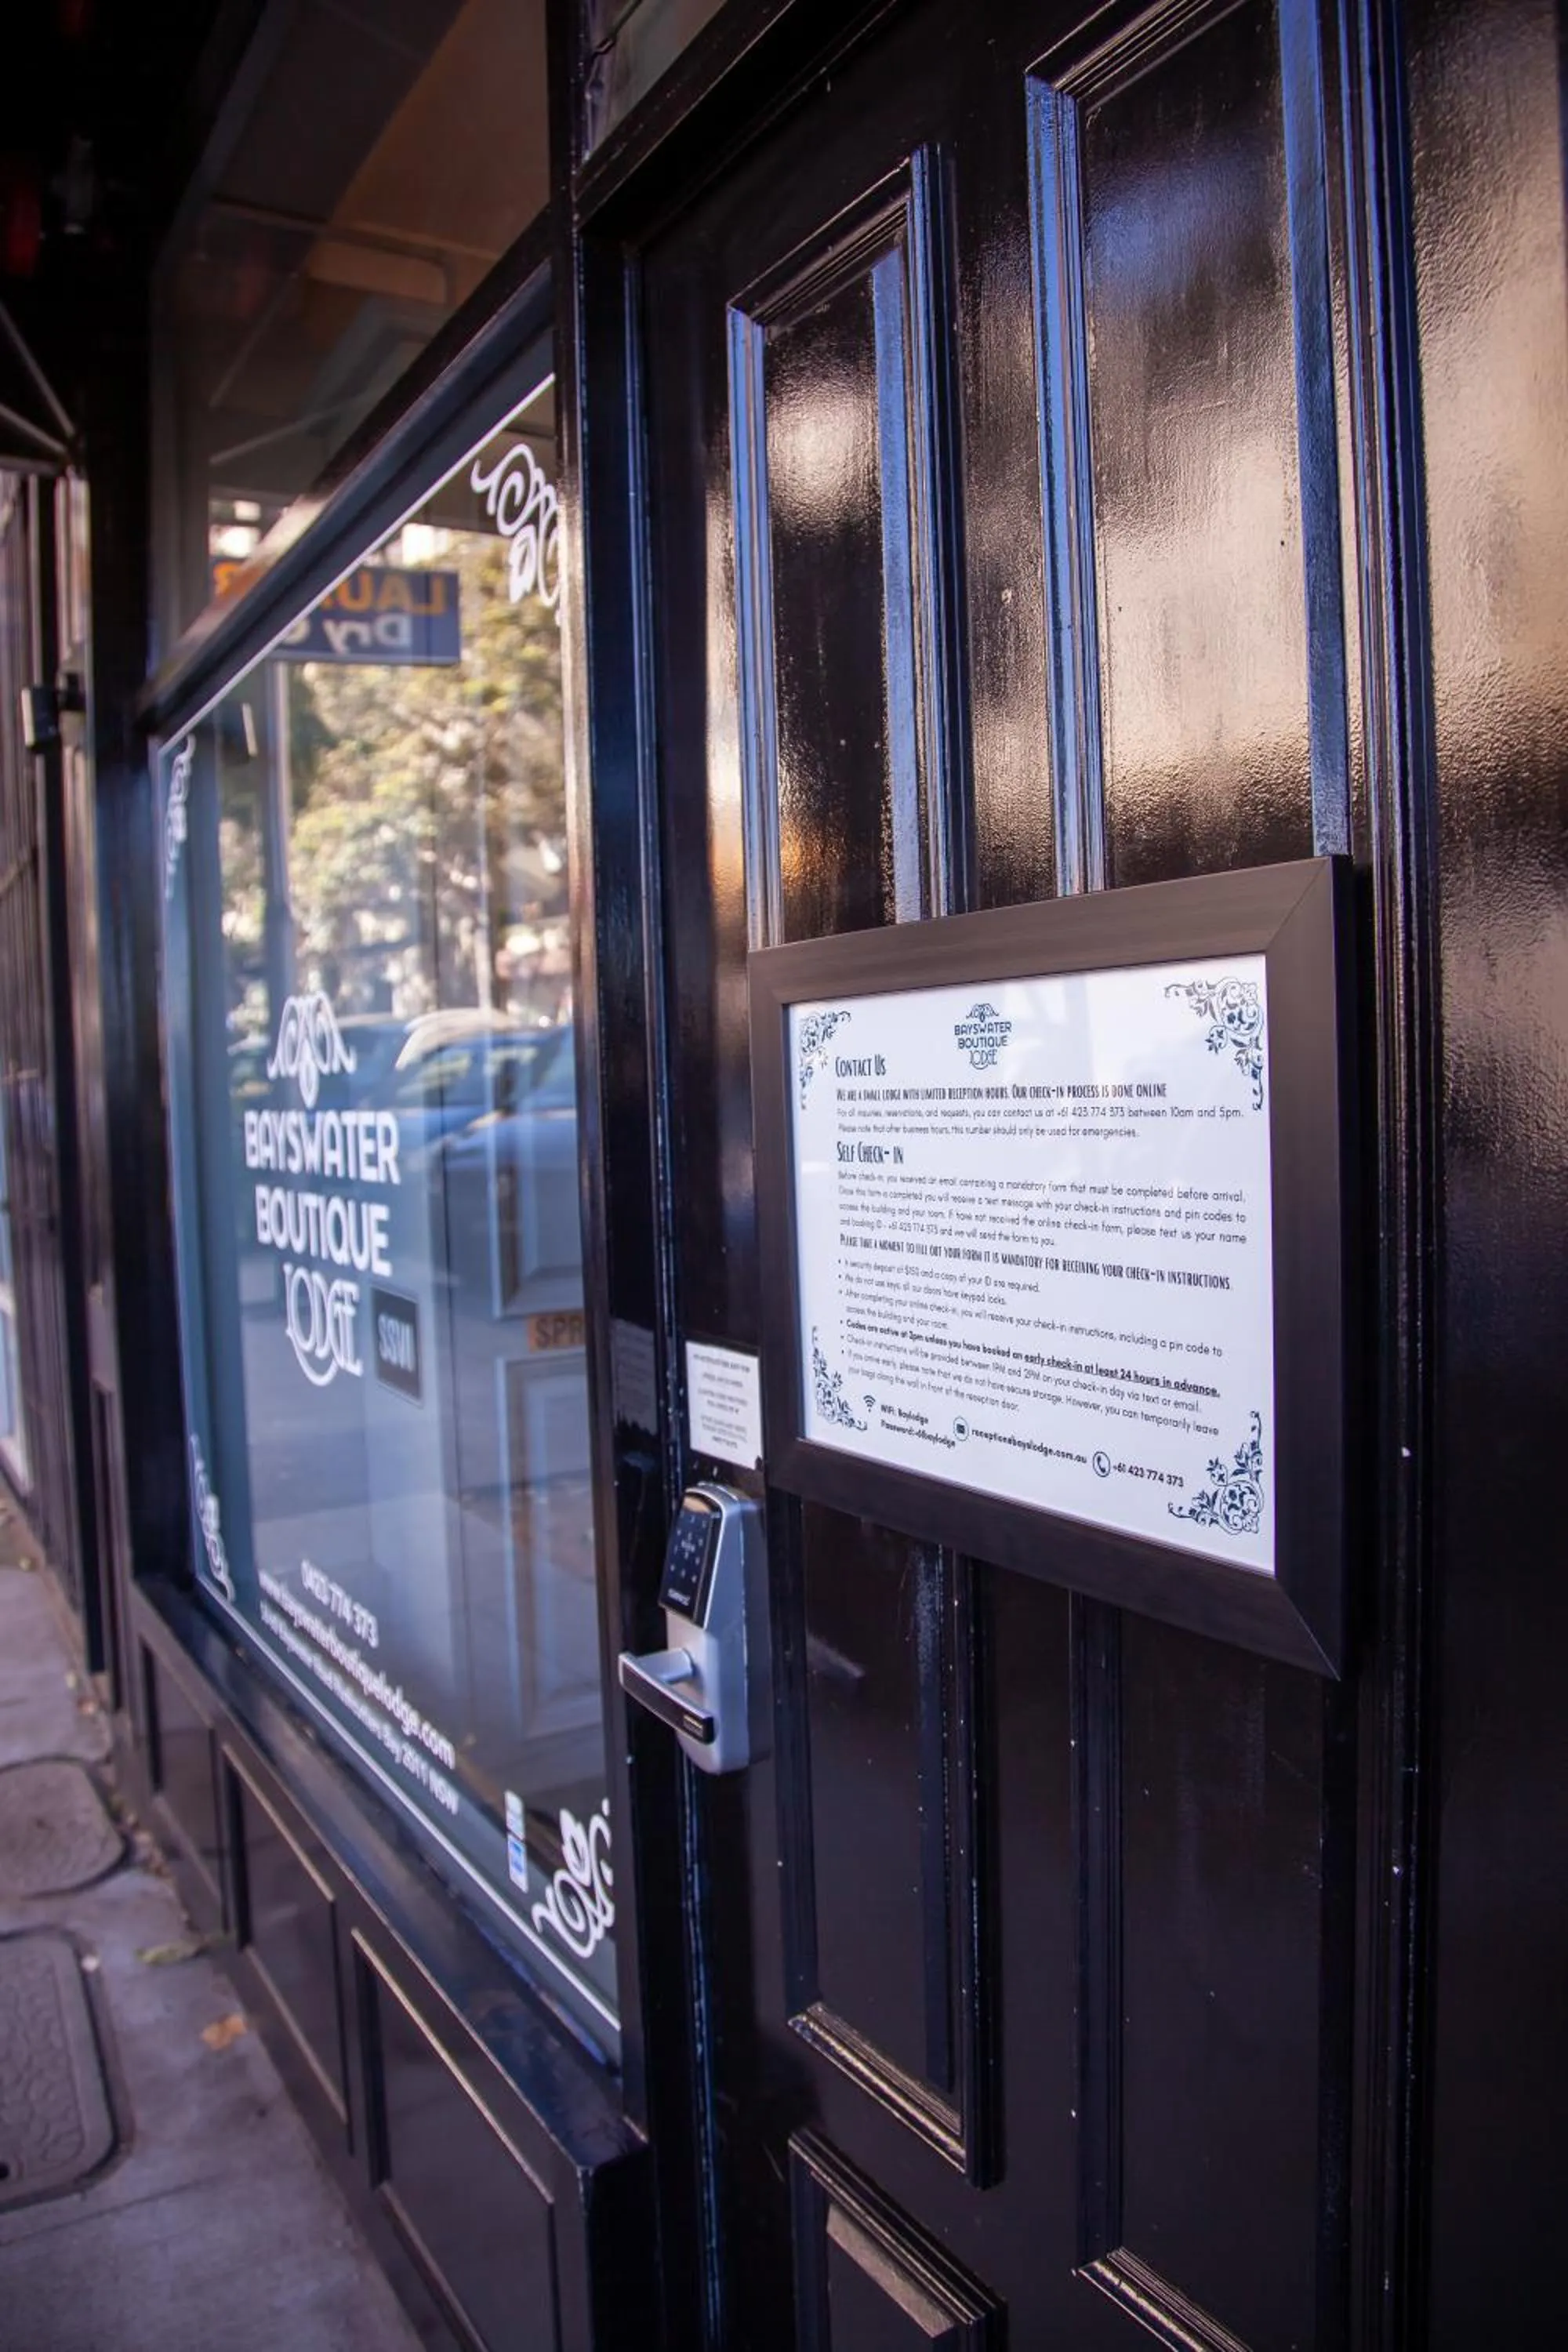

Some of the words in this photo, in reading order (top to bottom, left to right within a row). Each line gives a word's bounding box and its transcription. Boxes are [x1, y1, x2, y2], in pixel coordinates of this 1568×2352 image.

[954, 1021, 1012, 1036] BAYSWATER
[958, 1035, 1009, 1049] BOUTIQUE
[835, 1058, 871, 1078] CONTACT
[874, 1054, 885, 1076] US
[1011, 1085, 1027, 1099] OUR
[1029, 1085, 1064, 1098] CHECK-IN
[1066, 1084, 1099, 1098] PROCESS
[1101, 1084, 1109, 1098] IS
[1112, 1083, 1132, 1098] DONE
[1135, 1083, 1166, 1098] ONLINE
[972, 1109, 985, 1118] you
[1003, 1108, 1032, 1117] contact
[1071, 1106, 1088, 1117] 423
[1091, 1106, 1106, 1116] 774
[1109, 1106, 1124, 1117] 373
[1127, 1106, 1167, 1117] between
[1170, 1106, 1193, 1117] 10am
[1197, 1105, 1215, 1117] and
[1218, 1105, 1243, 1119] 5pm.
[244, 1109, 401, 1185] BAYSWATER
[1069, 1182, 1086, 1193] that
[1089, 1185, 1109, 1195] must
[1126, 1186, 1173, 1200] completed
[1177, 1187, 1208, 1200] before
[1211, 1190, 1245, 1203] arrival.
[1036, 1199, 1052, 1209] with
[1054, 1202, 1071, 1212] your
[1073, 1200, 1109, 1213] check-in
[1111, 1205, 1160, 1217] instructions
[1164, 1207, 1181, 1218] and
[1185, 1209, 1200, 1221] pin
[1203, 1209, 1232, 1222] codes
[255, 1184, 393, 1277] BOUTIQUE
[1037, 1216, 1061, 1229] online
[1063, 1218, 1098, 1231] check-in
[1127, 1223, 1156, 1236] please
[1159, 1226, 1177, 1237] text
[1194, 1231, 1215, 1242] your
[1218, 1232, 1247, 1243] name
[1000, 1253, 1042, 1269] MANDATORY
[1044, 1257, 1059, 1271] FOR
[1062, 1258, 1099, 1275] RECEIVING
[1102, 1262, 1123, 1278] YOUR
[1125, 1266, 1165, 1282] CHECK-IN
[283, 1261, 363, 1388] LODGE
[1119, 1333, 1158, 1349] including
[1168, 1341, 1182, 1352] pin
[1185, 1343, 1210, 1355] code
[1024, 1352, 1045, 1367] early
[1046, 1355, 1083, 1373] check-in
[1094, 1363, 1119, 1379] least
[1132, 1370, 1160, 1387] hours
[1173, 1379, 1220, 1398] advance.
[1127, 1465, 1144, 1478] 423
[1146, 1468, 1163, 1483] 774
[1166, 1473, 1183, 1488] 373
[353, 1602, 378, 1648] 373
